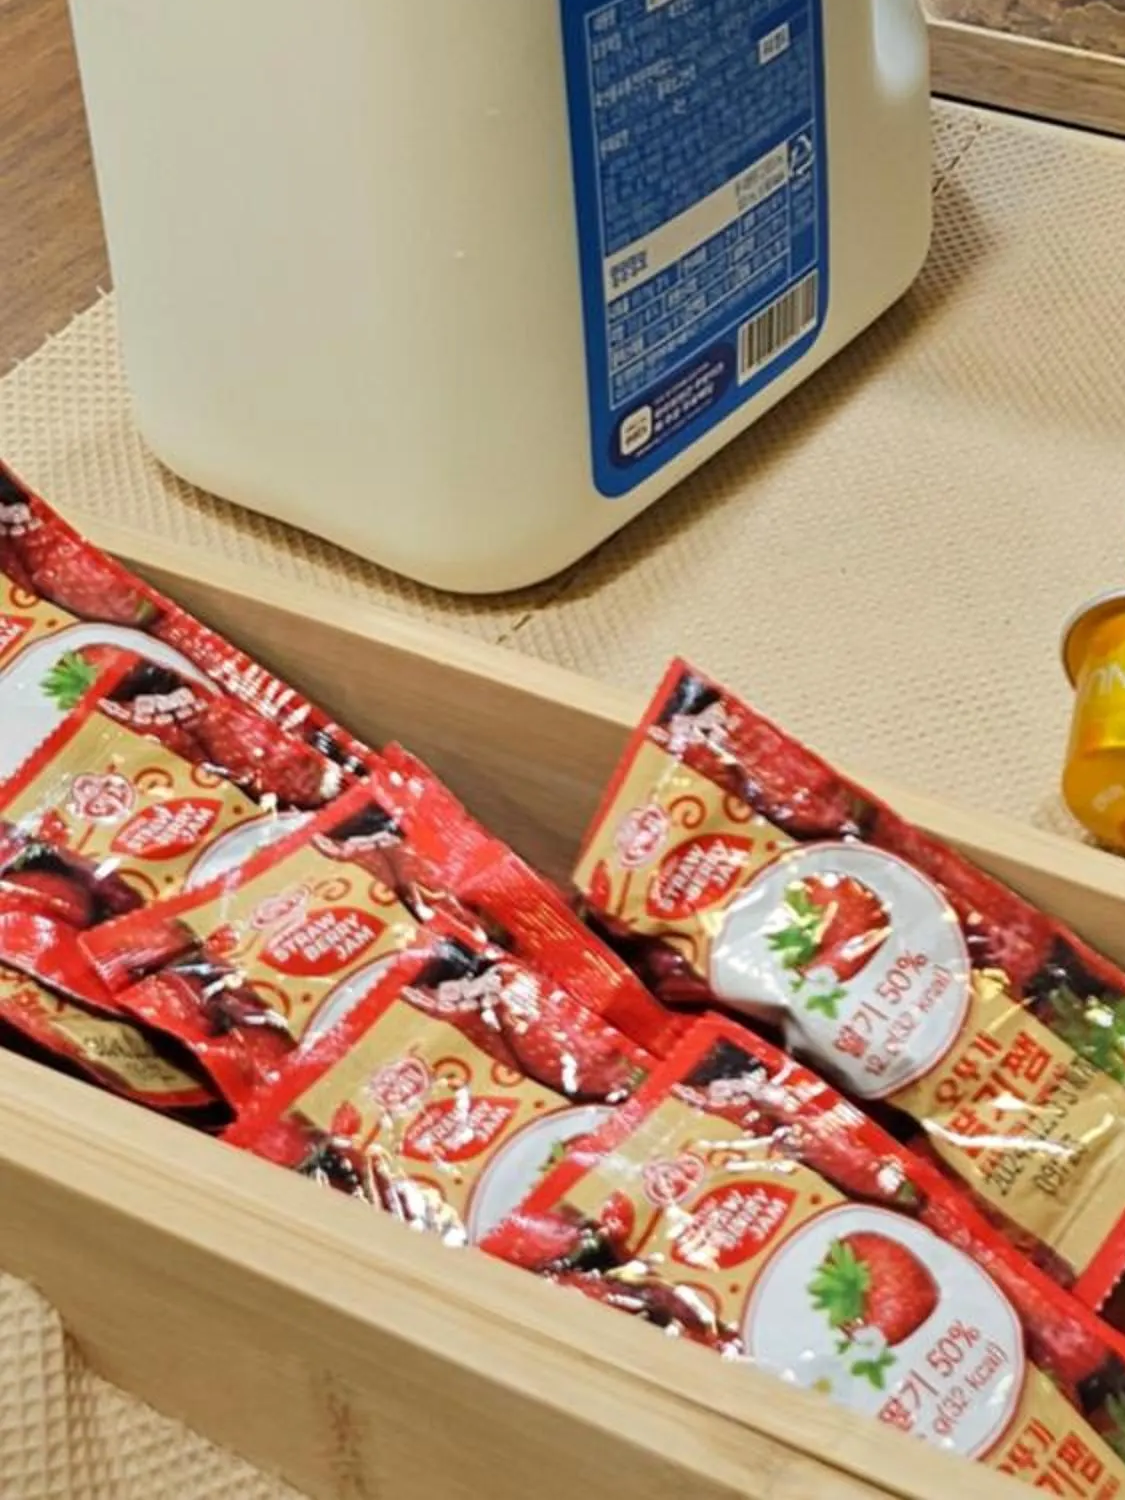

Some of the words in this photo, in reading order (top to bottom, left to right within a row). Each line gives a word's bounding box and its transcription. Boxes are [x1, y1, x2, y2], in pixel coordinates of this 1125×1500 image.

[272, 910, 336, 962] STRAW
[304, 912, 361, 963] BERRY
[336, 924, 377, 962] JAM
[874, 949, 928, 1005] 50%
[877, 1367, 940, 1433] 딸기
[925, 1318, 981, 1378] 50%
